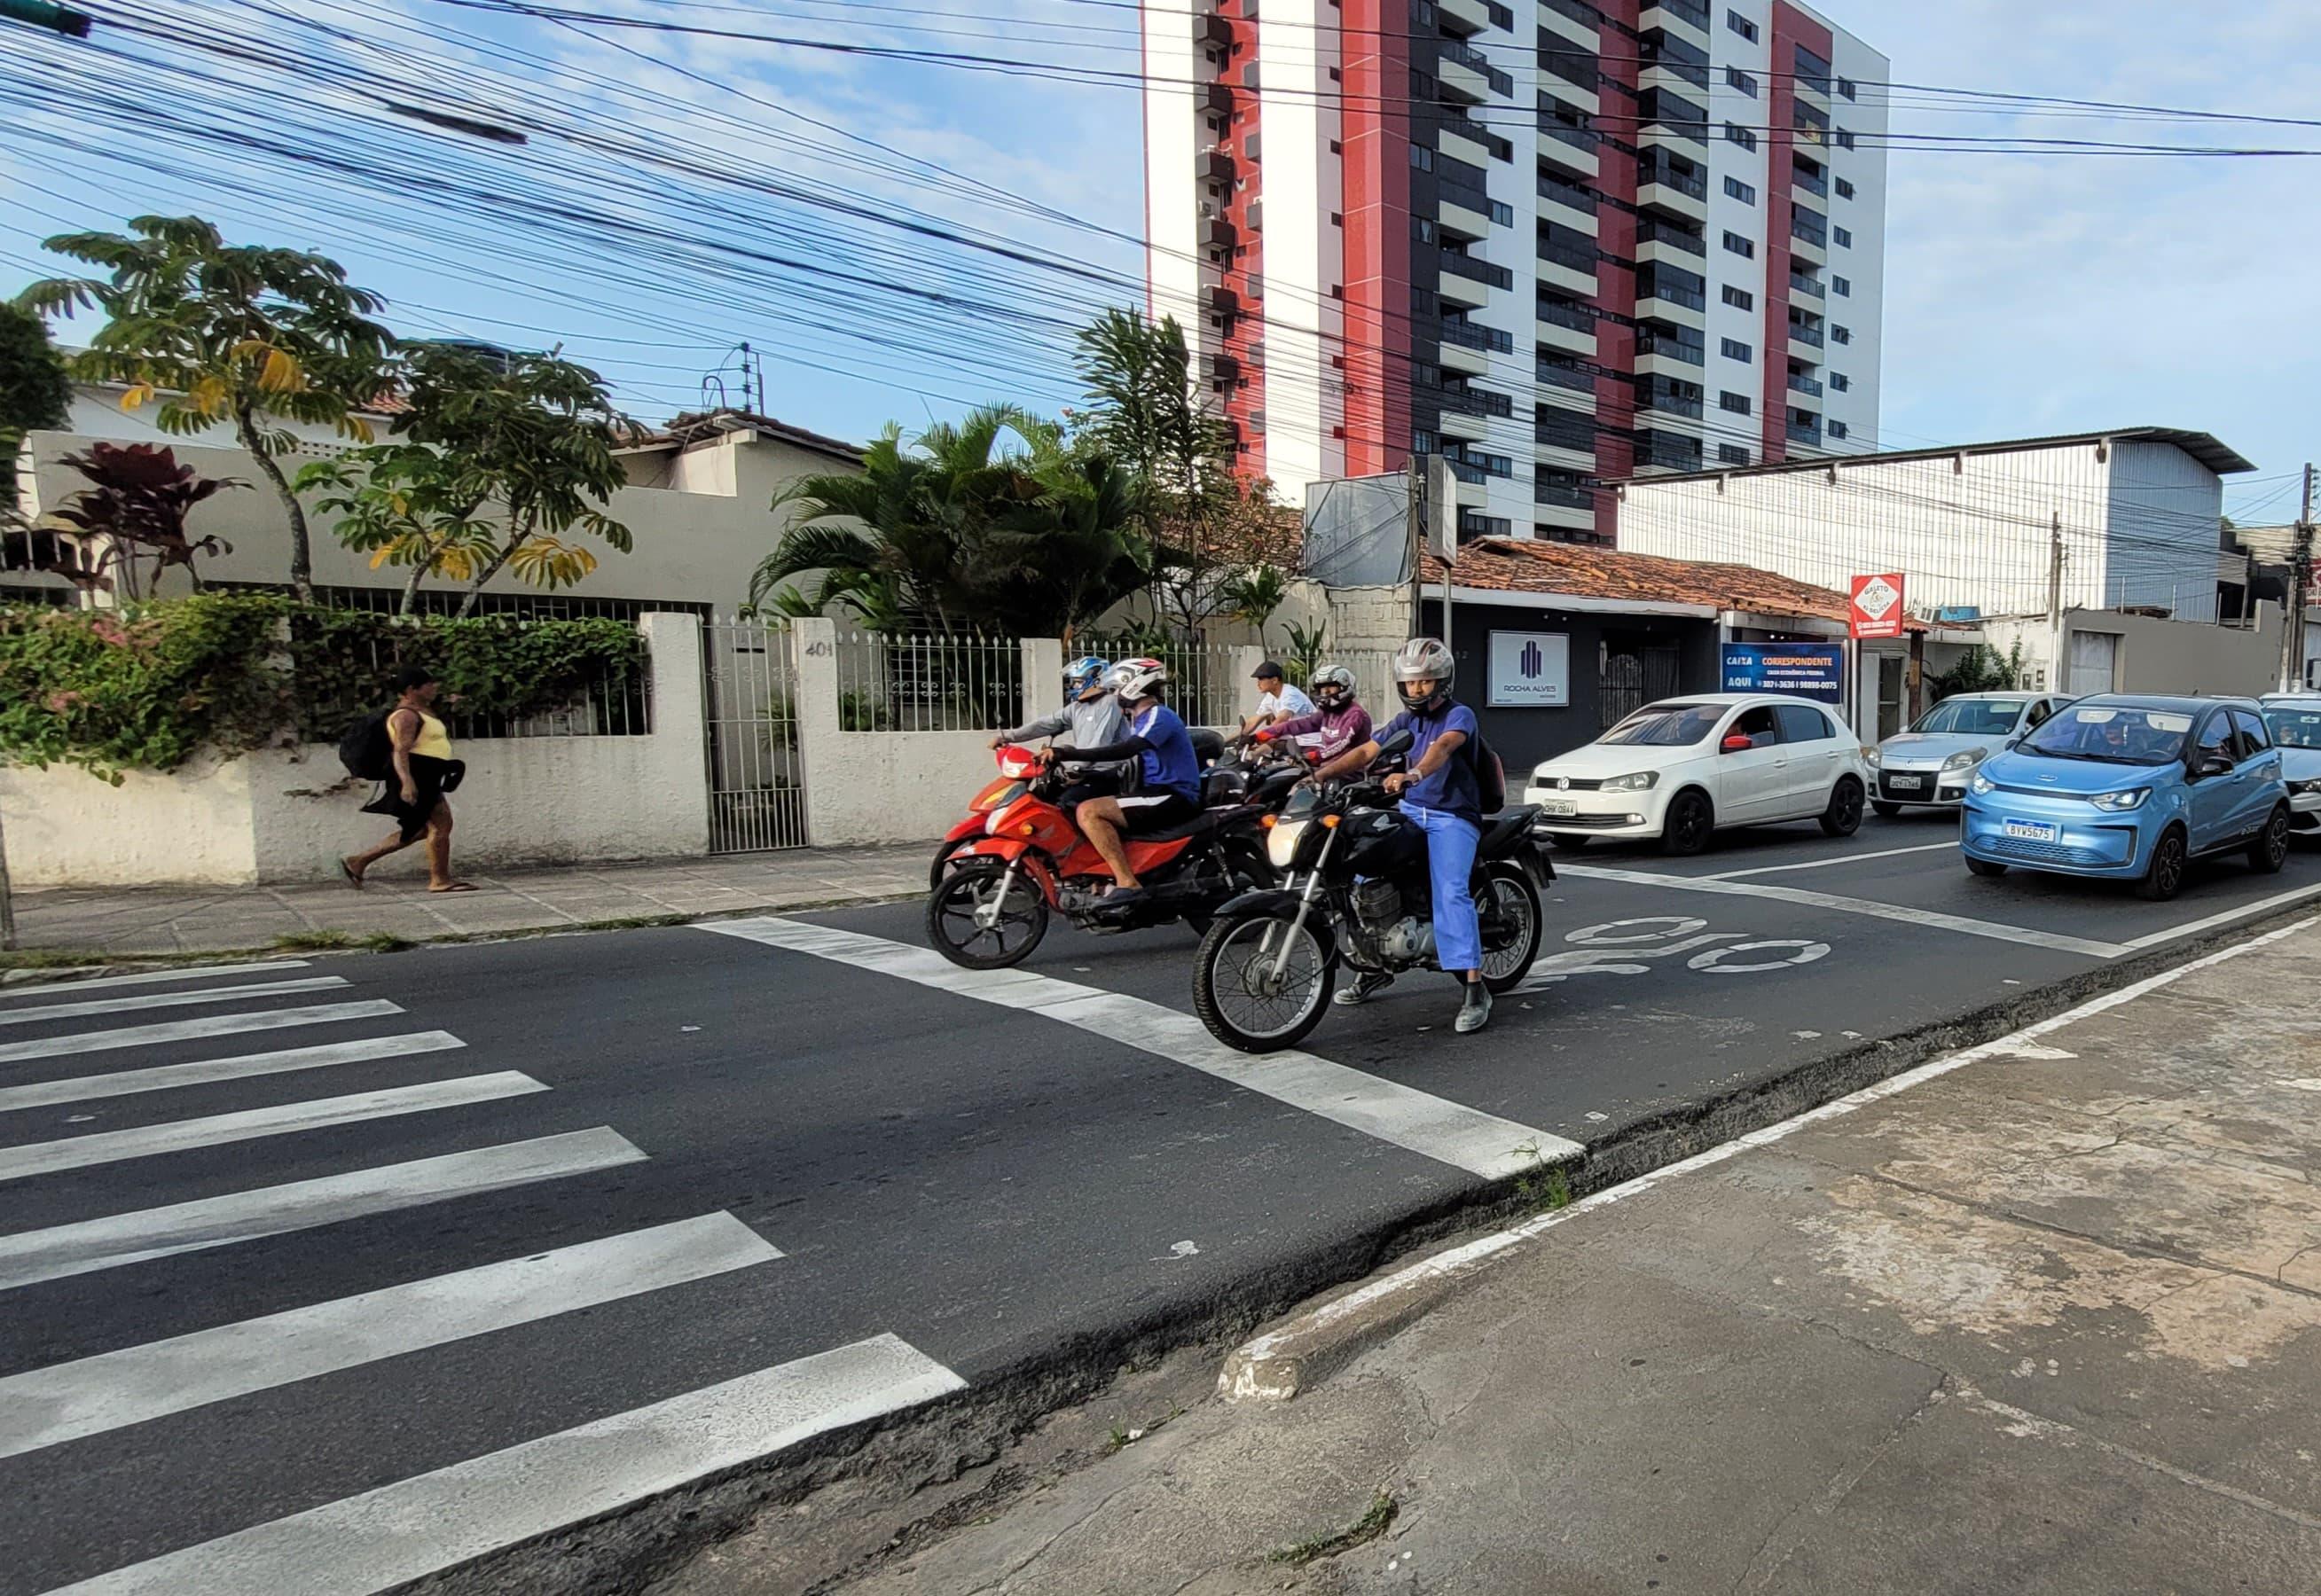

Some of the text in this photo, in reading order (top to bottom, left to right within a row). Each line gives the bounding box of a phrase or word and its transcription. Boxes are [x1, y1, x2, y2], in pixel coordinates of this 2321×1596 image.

[1864, 585, 1889, 595] GALETO
[806, 641, 833, 657] 401
[1726, 656, 1832, 667] CAIXA CORRESPONDENTE
[1728, 677, 1752, 687] AQUI
[2010, 825, 2050, 839] BYW5G75
